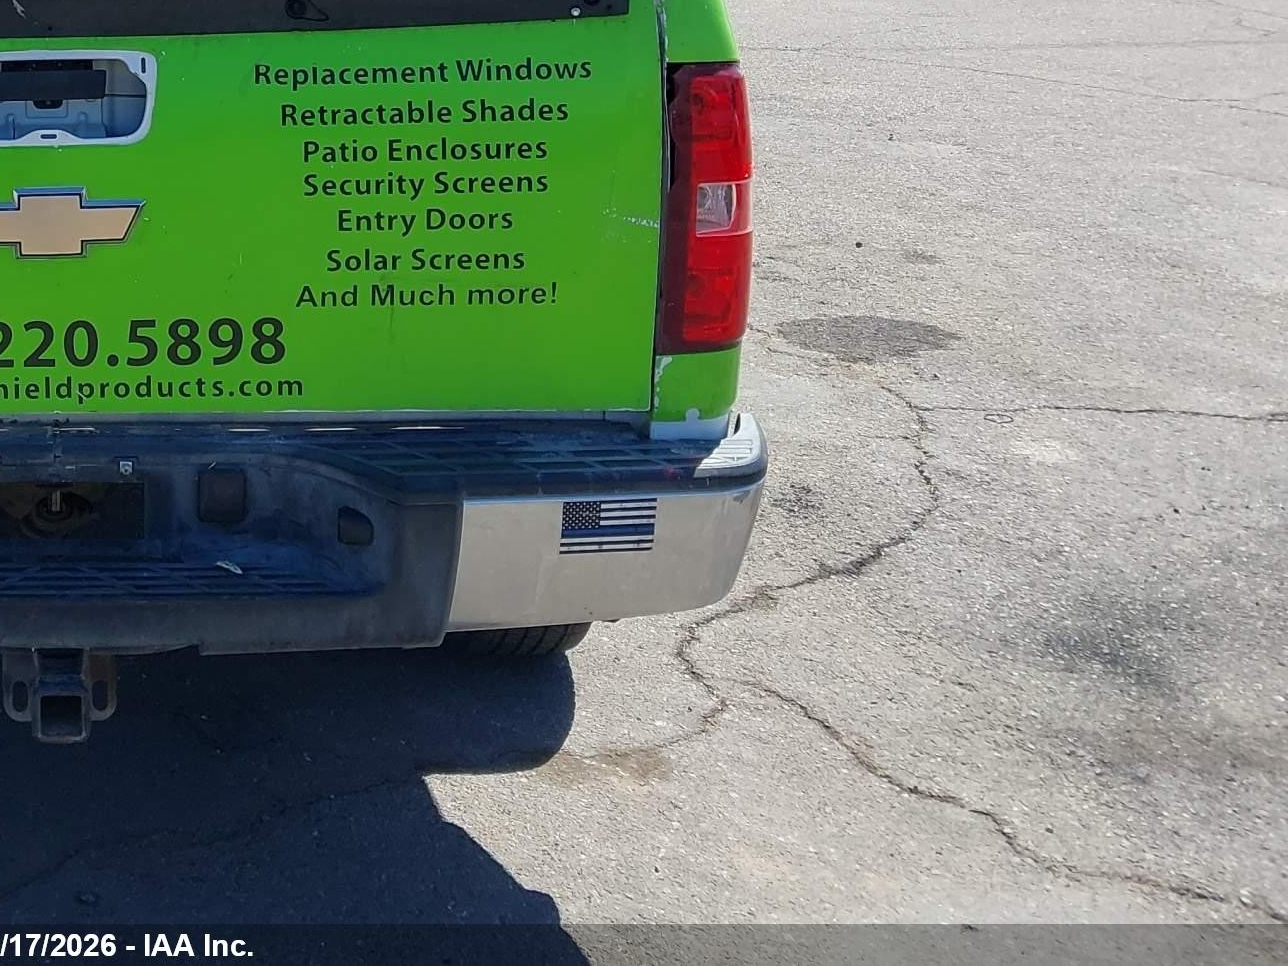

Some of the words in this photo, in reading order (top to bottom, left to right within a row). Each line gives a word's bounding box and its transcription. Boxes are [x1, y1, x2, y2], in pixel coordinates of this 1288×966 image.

[254, 62, 449, 92] Replacement
[455, 58, 592, 82] Windows
[281, 99, 452, 127] Retractable
[462, 97, 569, 123] Shades
[303, 139, 378, 163] Patio
[388, 136, 548, 162] Enclosures
[303, 171, 425, 200] Security
[434, 171, 549, 194] Screens
[338, 209, 417, 238] Entry
[426, 207, 513, 231] Doors
[326, 247, 402, 272] Solar
[411, 248, 525, 271] Screens
[295, 284, 358, 308] And
[371, 283, 455, 307] Much
[467, 281, 557, 305] more!
